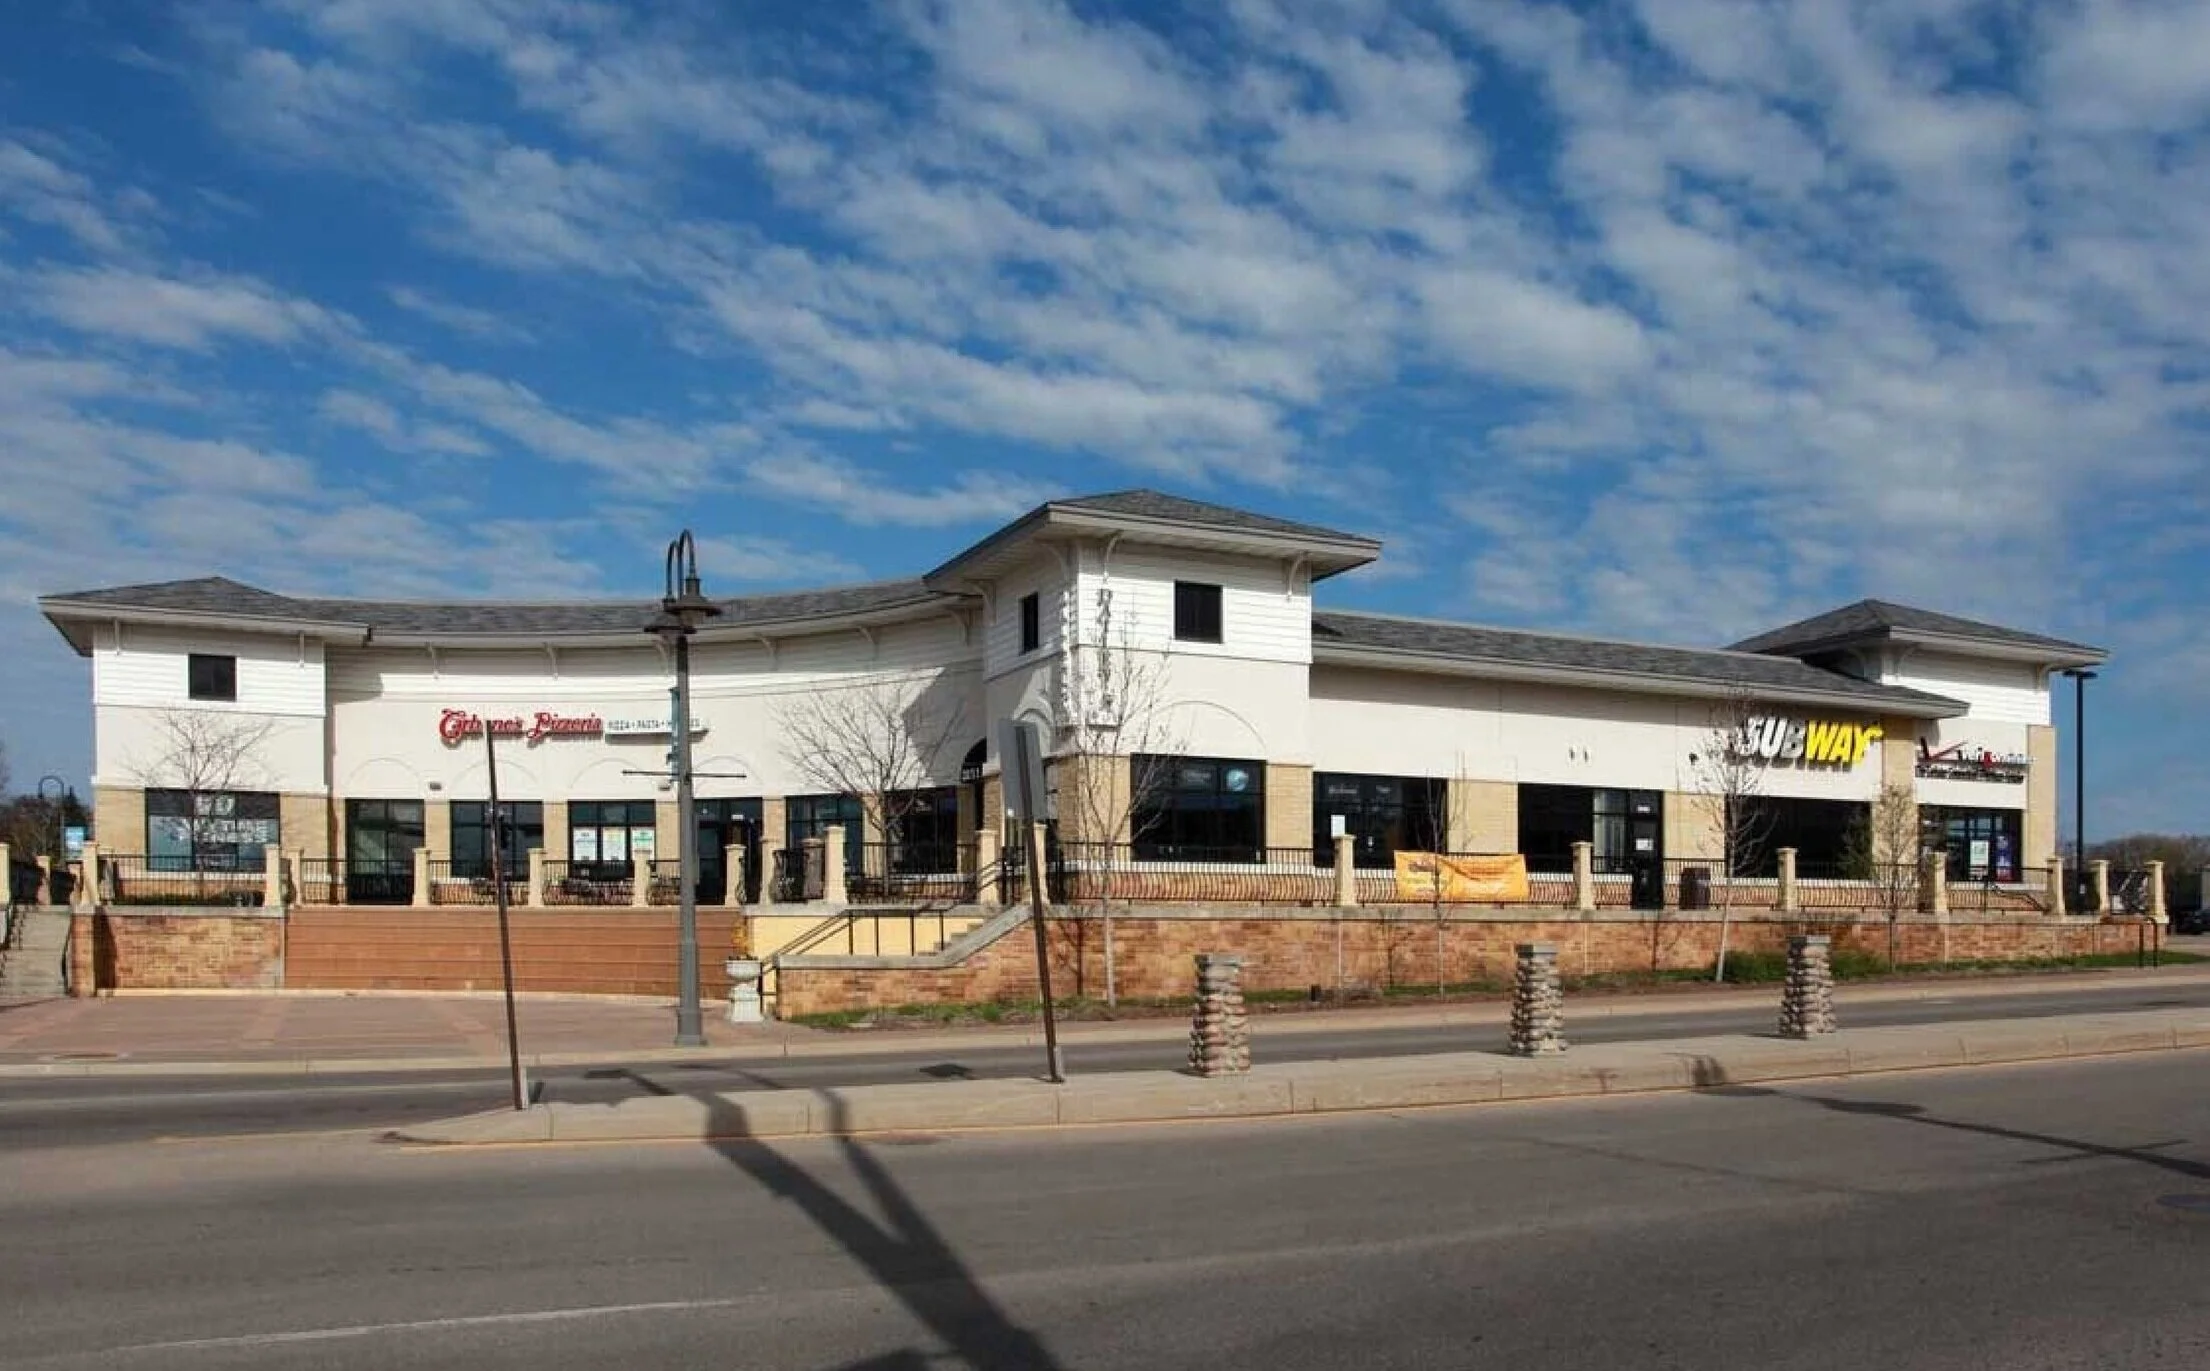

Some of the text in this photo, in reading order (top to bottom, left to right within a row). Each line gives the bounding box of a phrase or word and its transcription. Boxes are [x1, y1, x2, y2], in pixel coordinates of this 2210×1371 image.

[438, 708, 604, 739] Carbne's Pizzeria
[1737, 716, 1883, 763] SUBWAY
